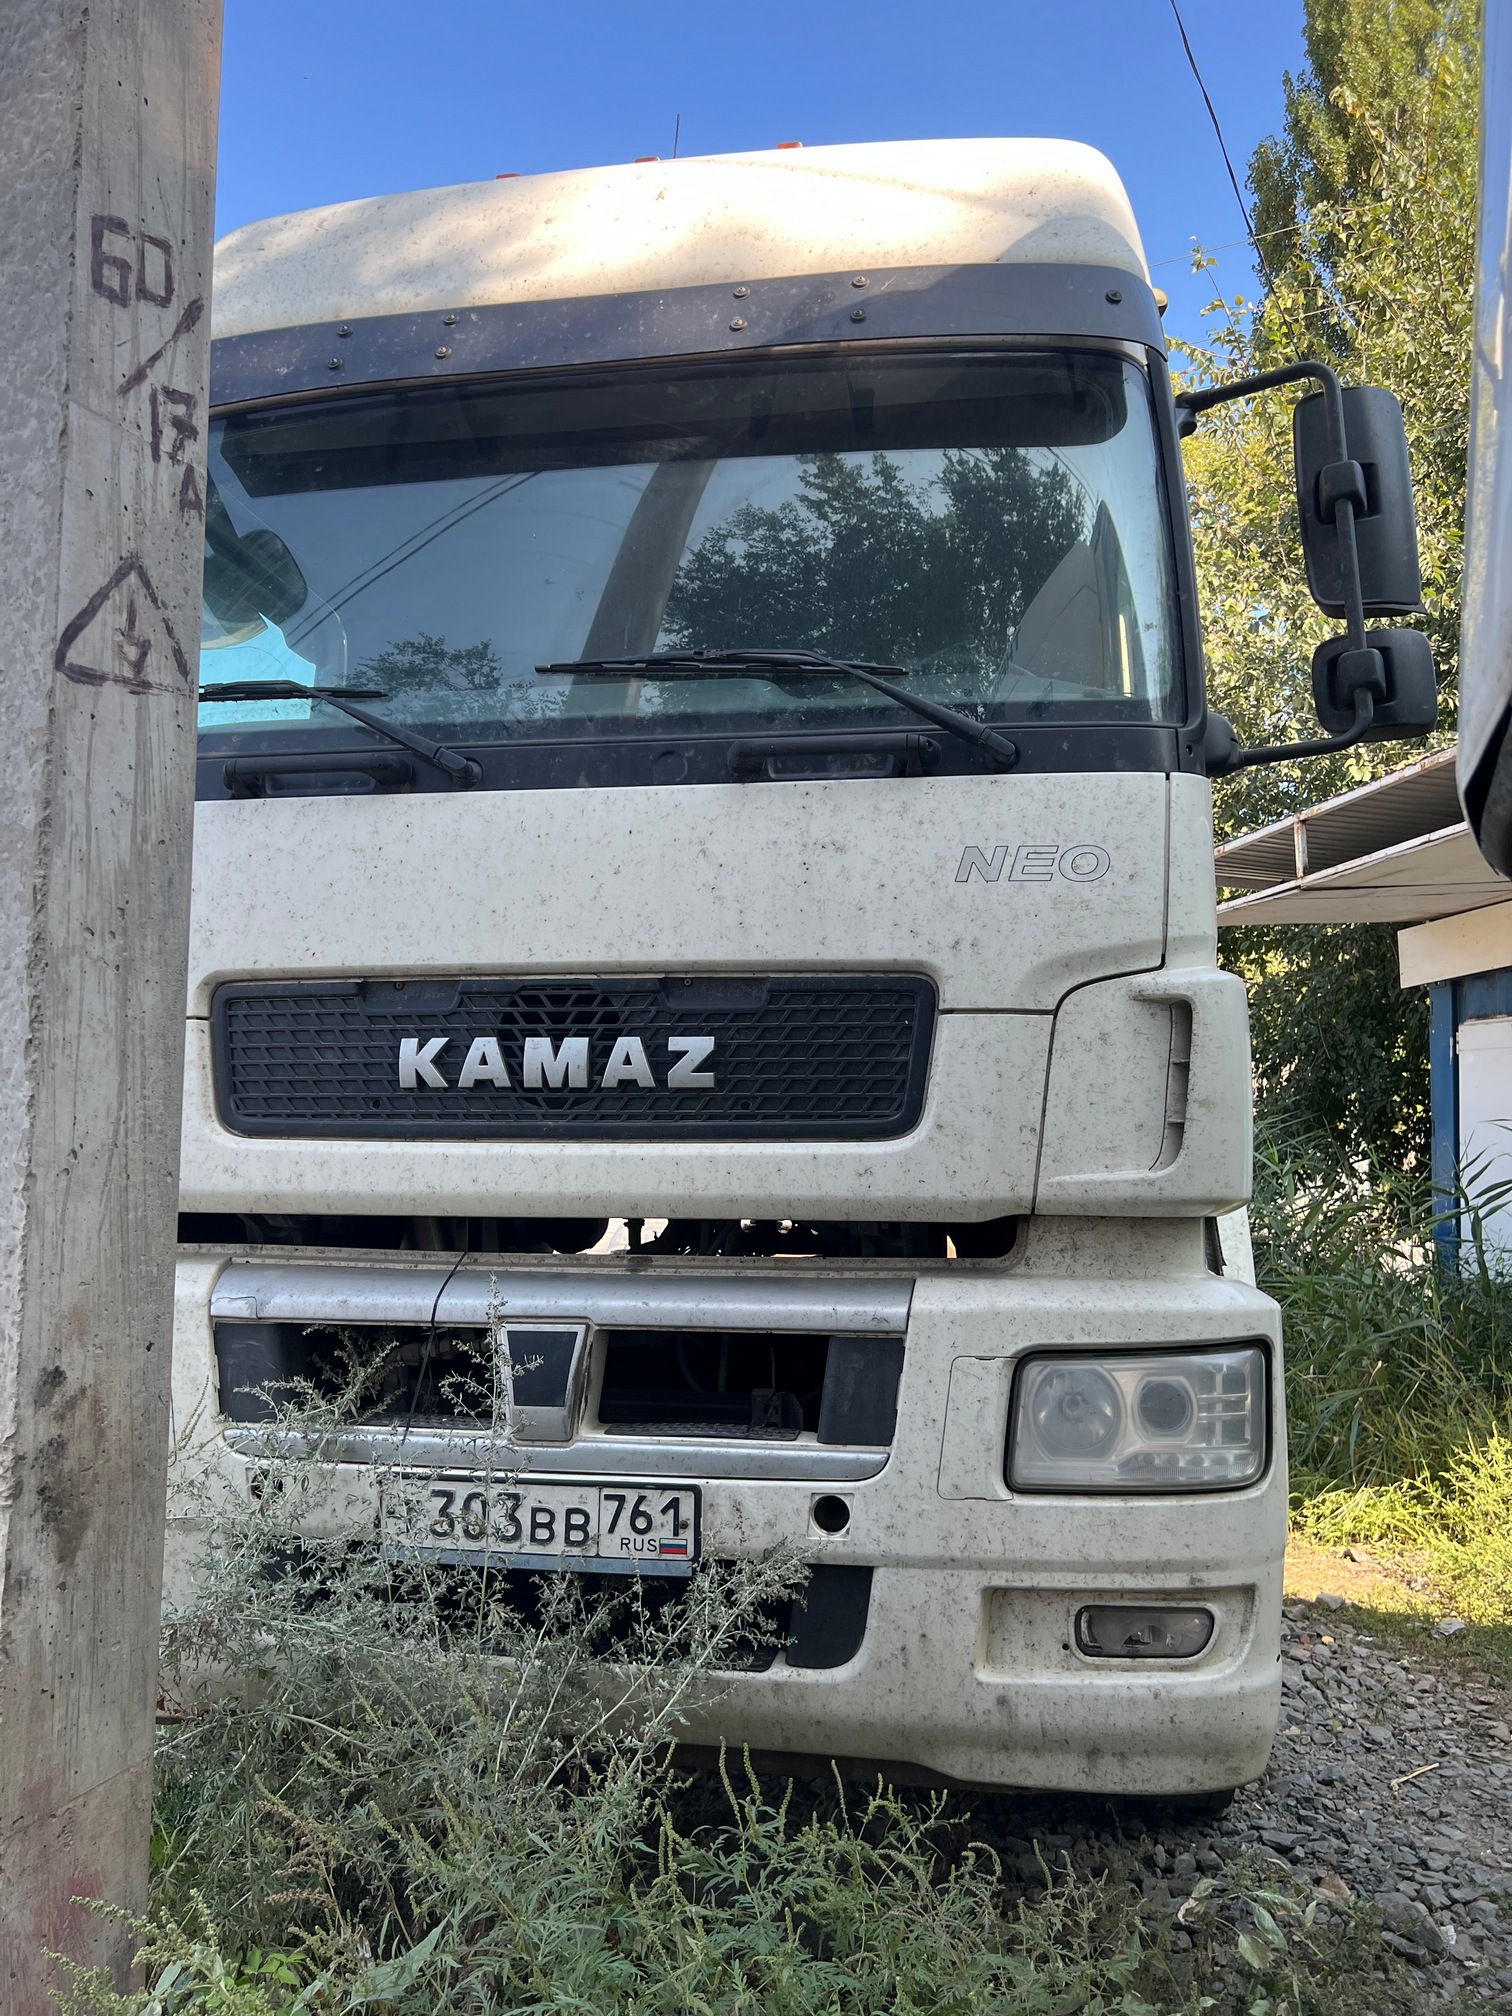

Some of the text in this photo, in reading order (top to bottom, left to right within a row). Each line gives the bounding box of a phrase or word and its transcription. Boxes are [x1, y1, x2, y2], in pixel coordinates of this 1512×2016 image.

[954, 844, 1111, 883] NEO
[398, 1036, 716, 1089] KAMAZ
[602, 1493, 681, 1537] 761
[619, 1537, 658, 1553] RUS
